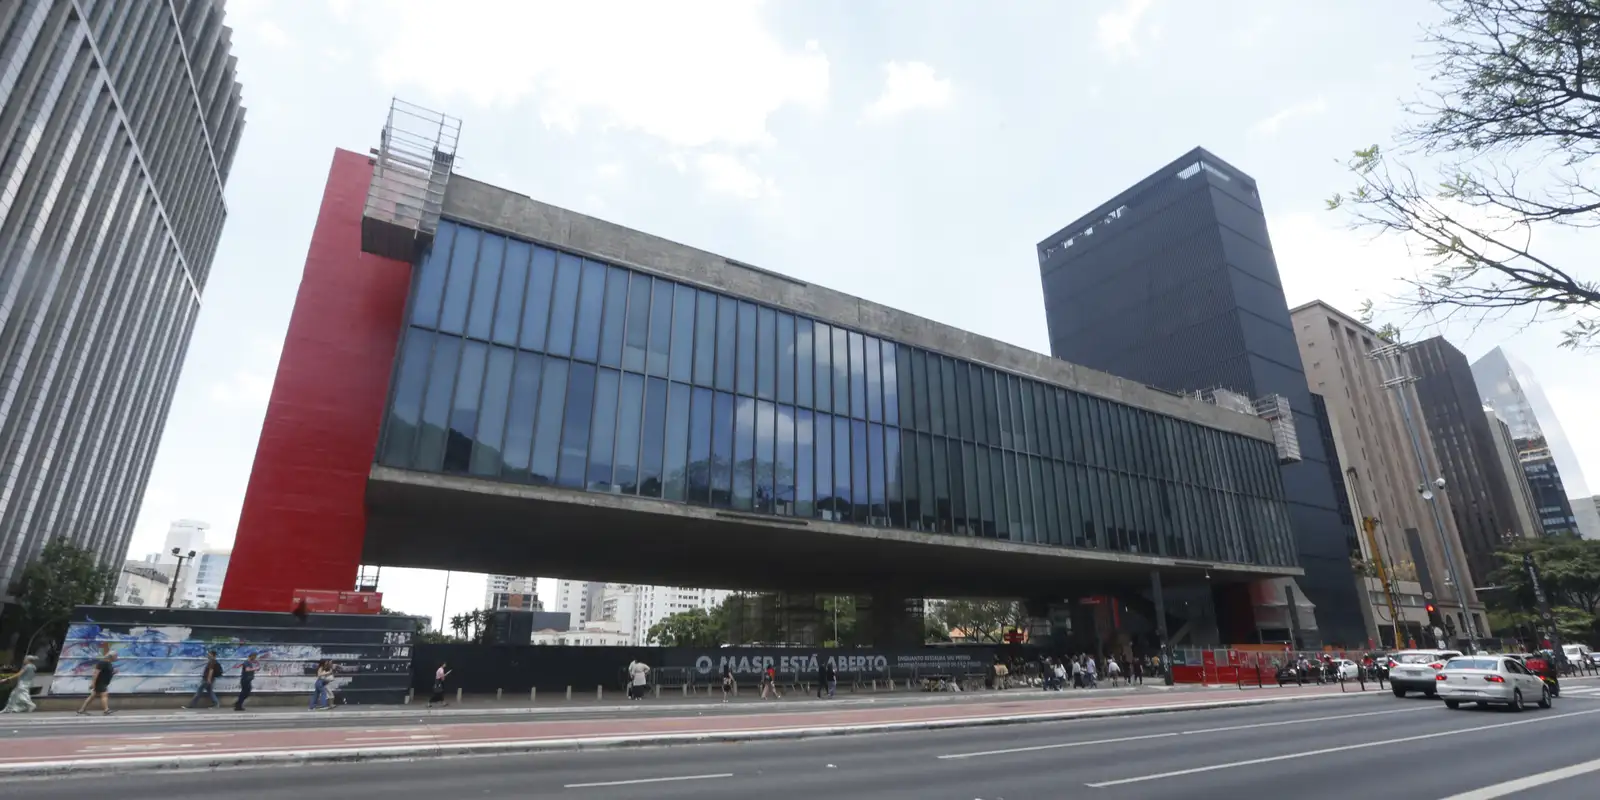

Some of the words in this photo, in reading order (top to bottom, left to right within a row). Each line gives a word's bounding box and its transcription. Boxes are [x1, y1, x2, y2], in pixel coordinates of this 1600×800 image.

[696, 656, 712, 674] O
[719, 656, 774, 673] MASP
[780, 654, 819, 673] ESTÁ
[826, 655, 887, 672] ABERTO
